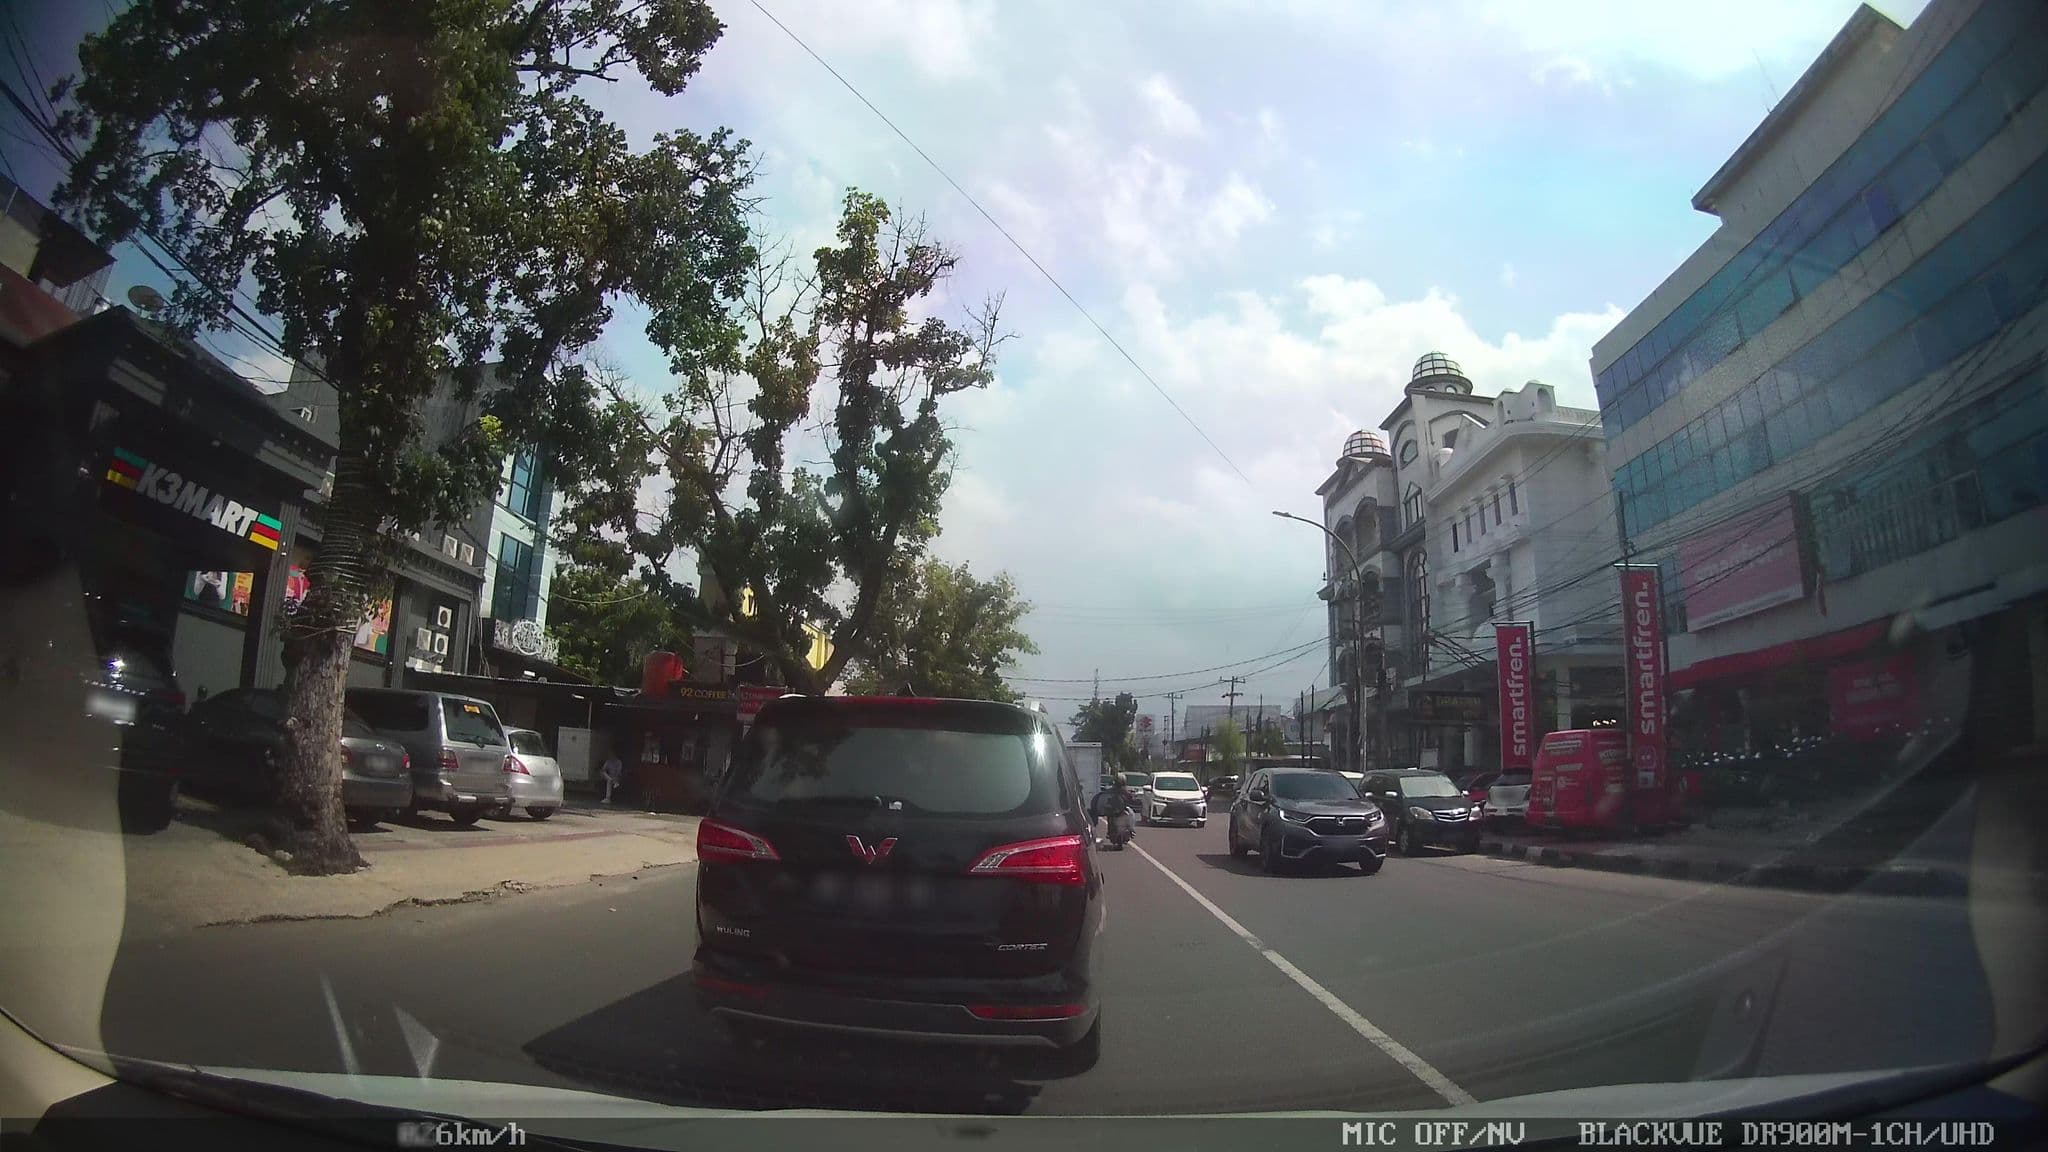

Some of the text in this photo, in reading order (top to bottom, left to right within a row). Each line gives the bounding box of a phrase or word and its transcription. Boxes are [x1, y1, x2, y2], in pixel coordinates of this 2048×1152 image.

[136, 462, 259, 537] K3MART
[680, 687, 728, 699] 92 COFFEE
[715, 926, 751, 937] WULING
[997, 943, 1048, 951] CORTEZ
